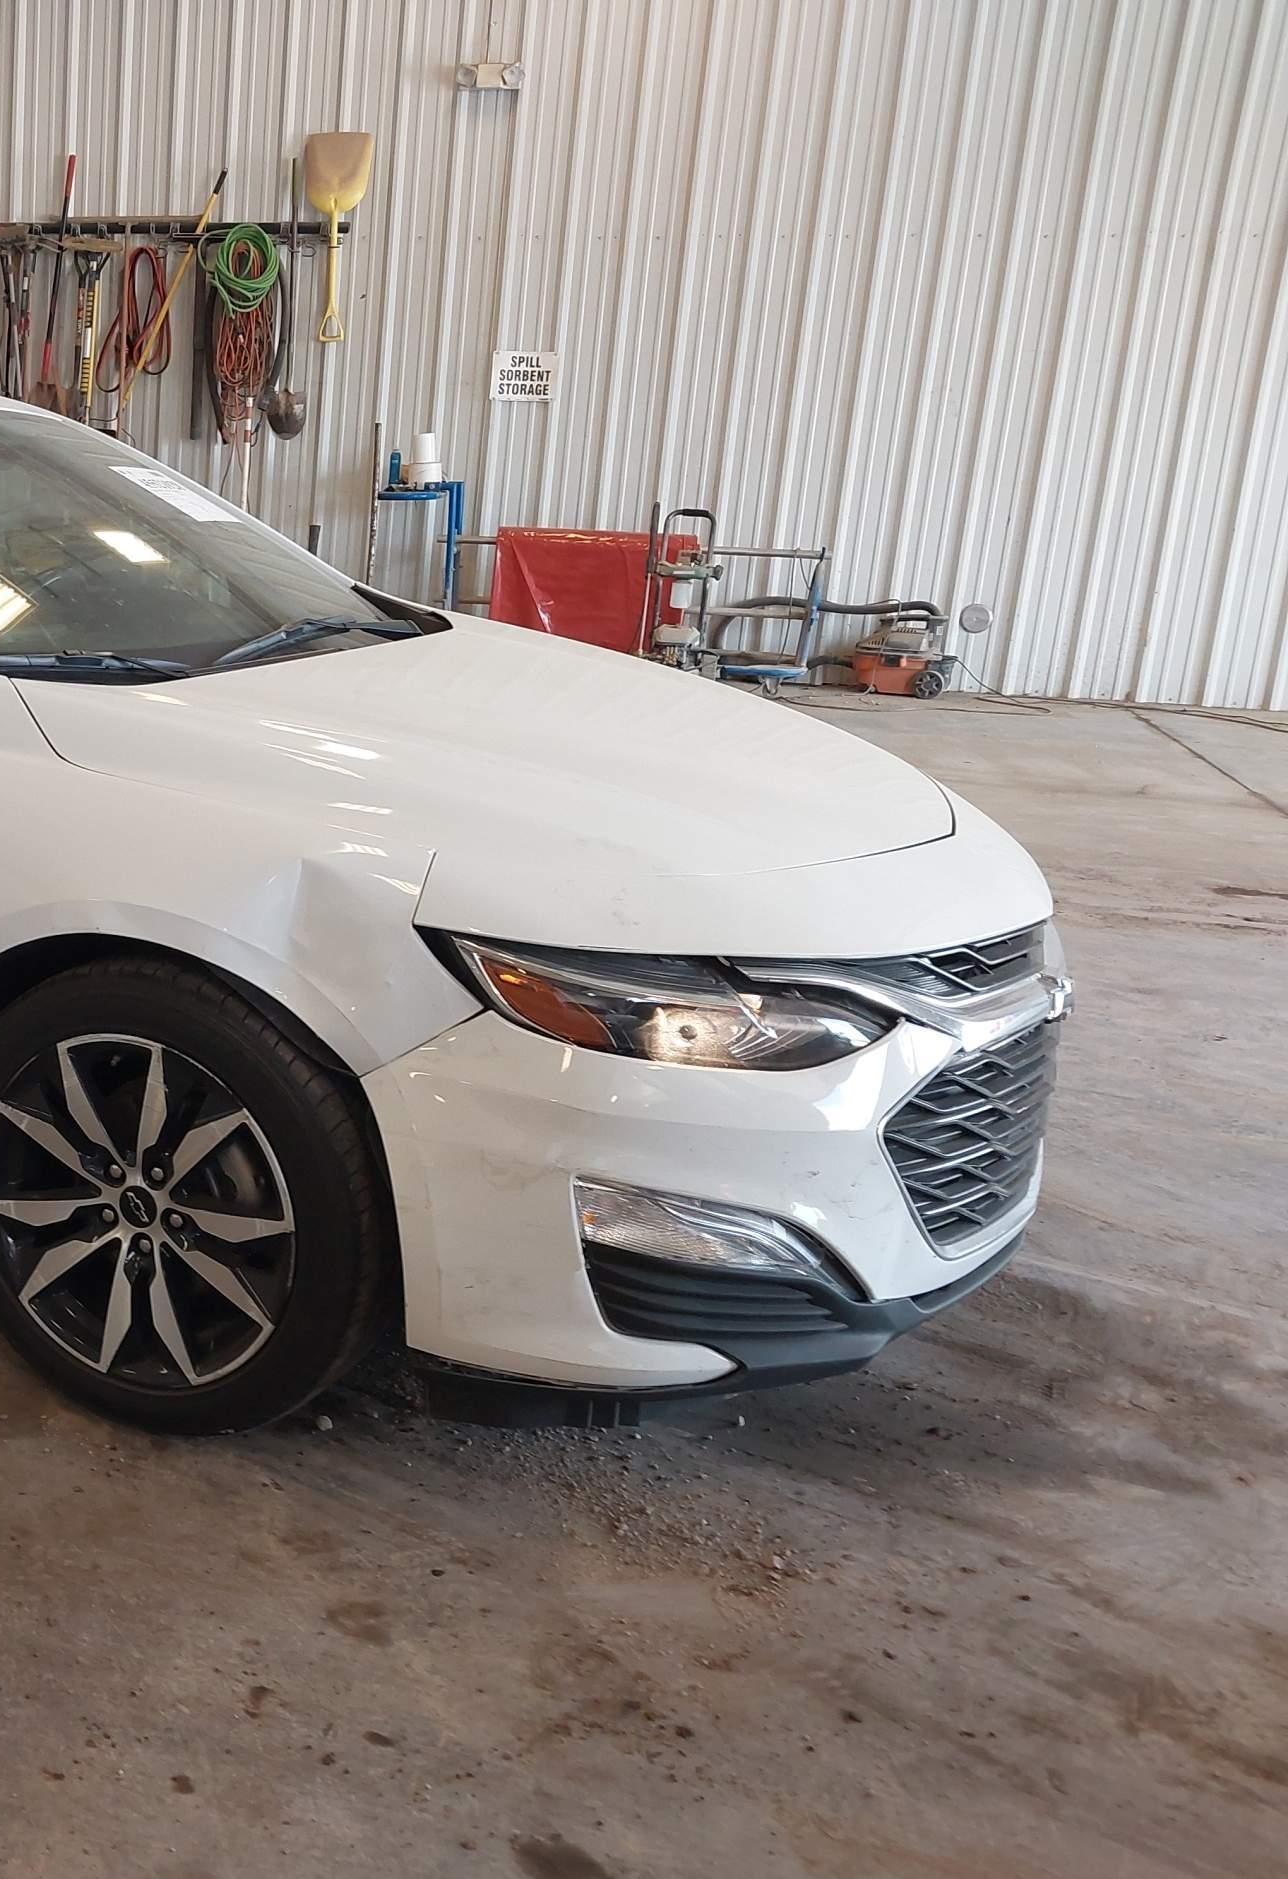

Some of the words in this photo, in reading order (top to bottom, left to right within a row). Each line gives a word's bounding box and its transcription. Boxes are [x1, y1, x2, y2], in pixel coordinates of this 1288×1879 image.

[511, 356, 542, 369] SPILL
[499, 369, 552, 382] SORBENT
[498, 383, 550, 396] STORAGE
